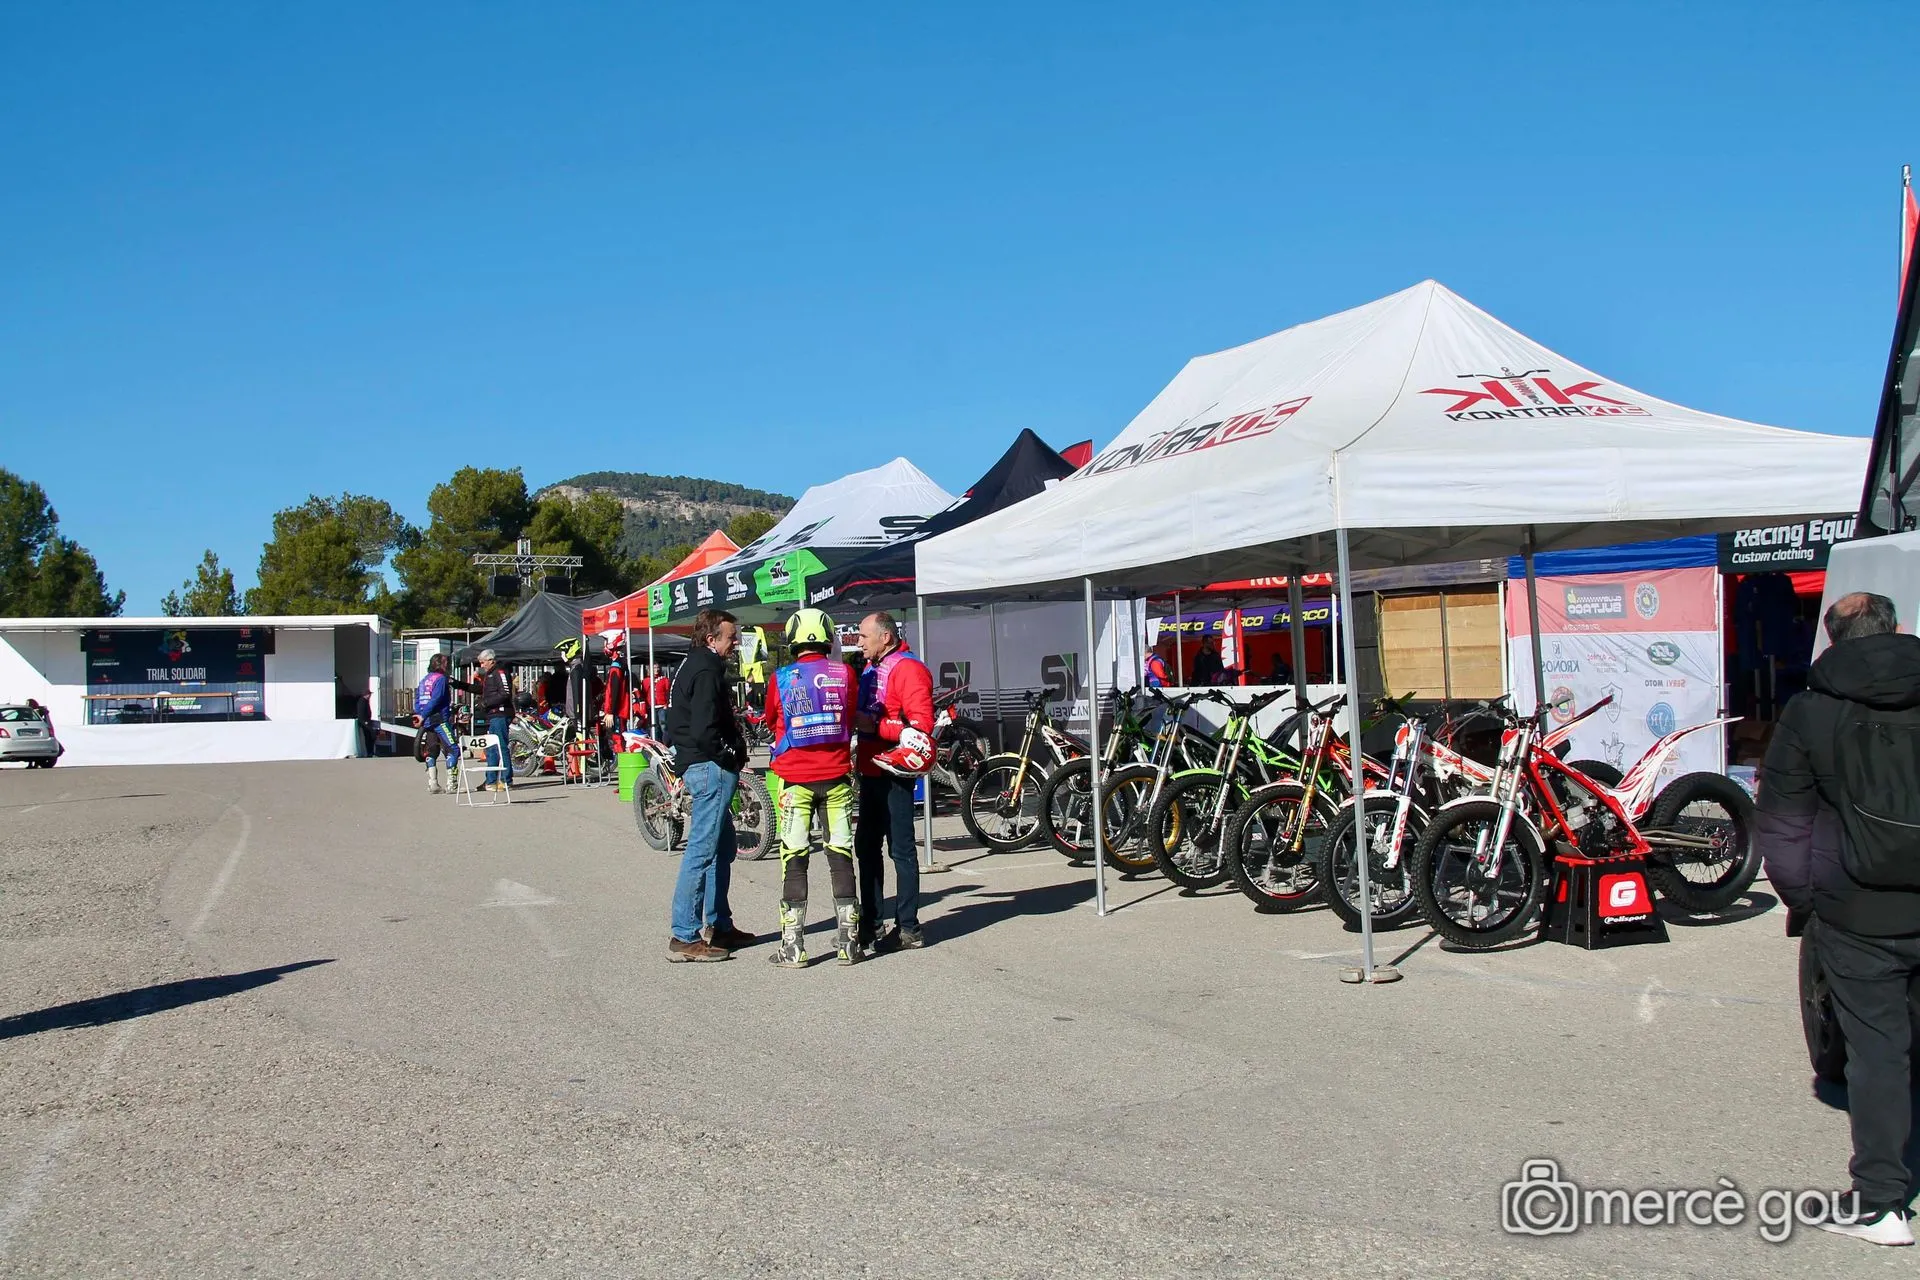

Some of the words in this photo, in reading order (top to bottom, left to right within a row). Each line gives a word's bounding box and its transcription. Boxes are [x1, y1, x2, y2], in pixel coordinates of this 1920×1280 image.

[1444, 405, 1653, 422] KONTRAKOS
[1734, 524, 1804, 547] Racing
[1732, 551, 1771, 564] Custom
[1772, 547, 1814, 561] clothing
[147, 668, 170, 681] TRIAL
[171, 667, 206, 681] SOLIDARI
[470, 738, 488, 748] 48
[1610, 881, 1637, 907] G
[1604, 914, 1648, 925] Polisport
